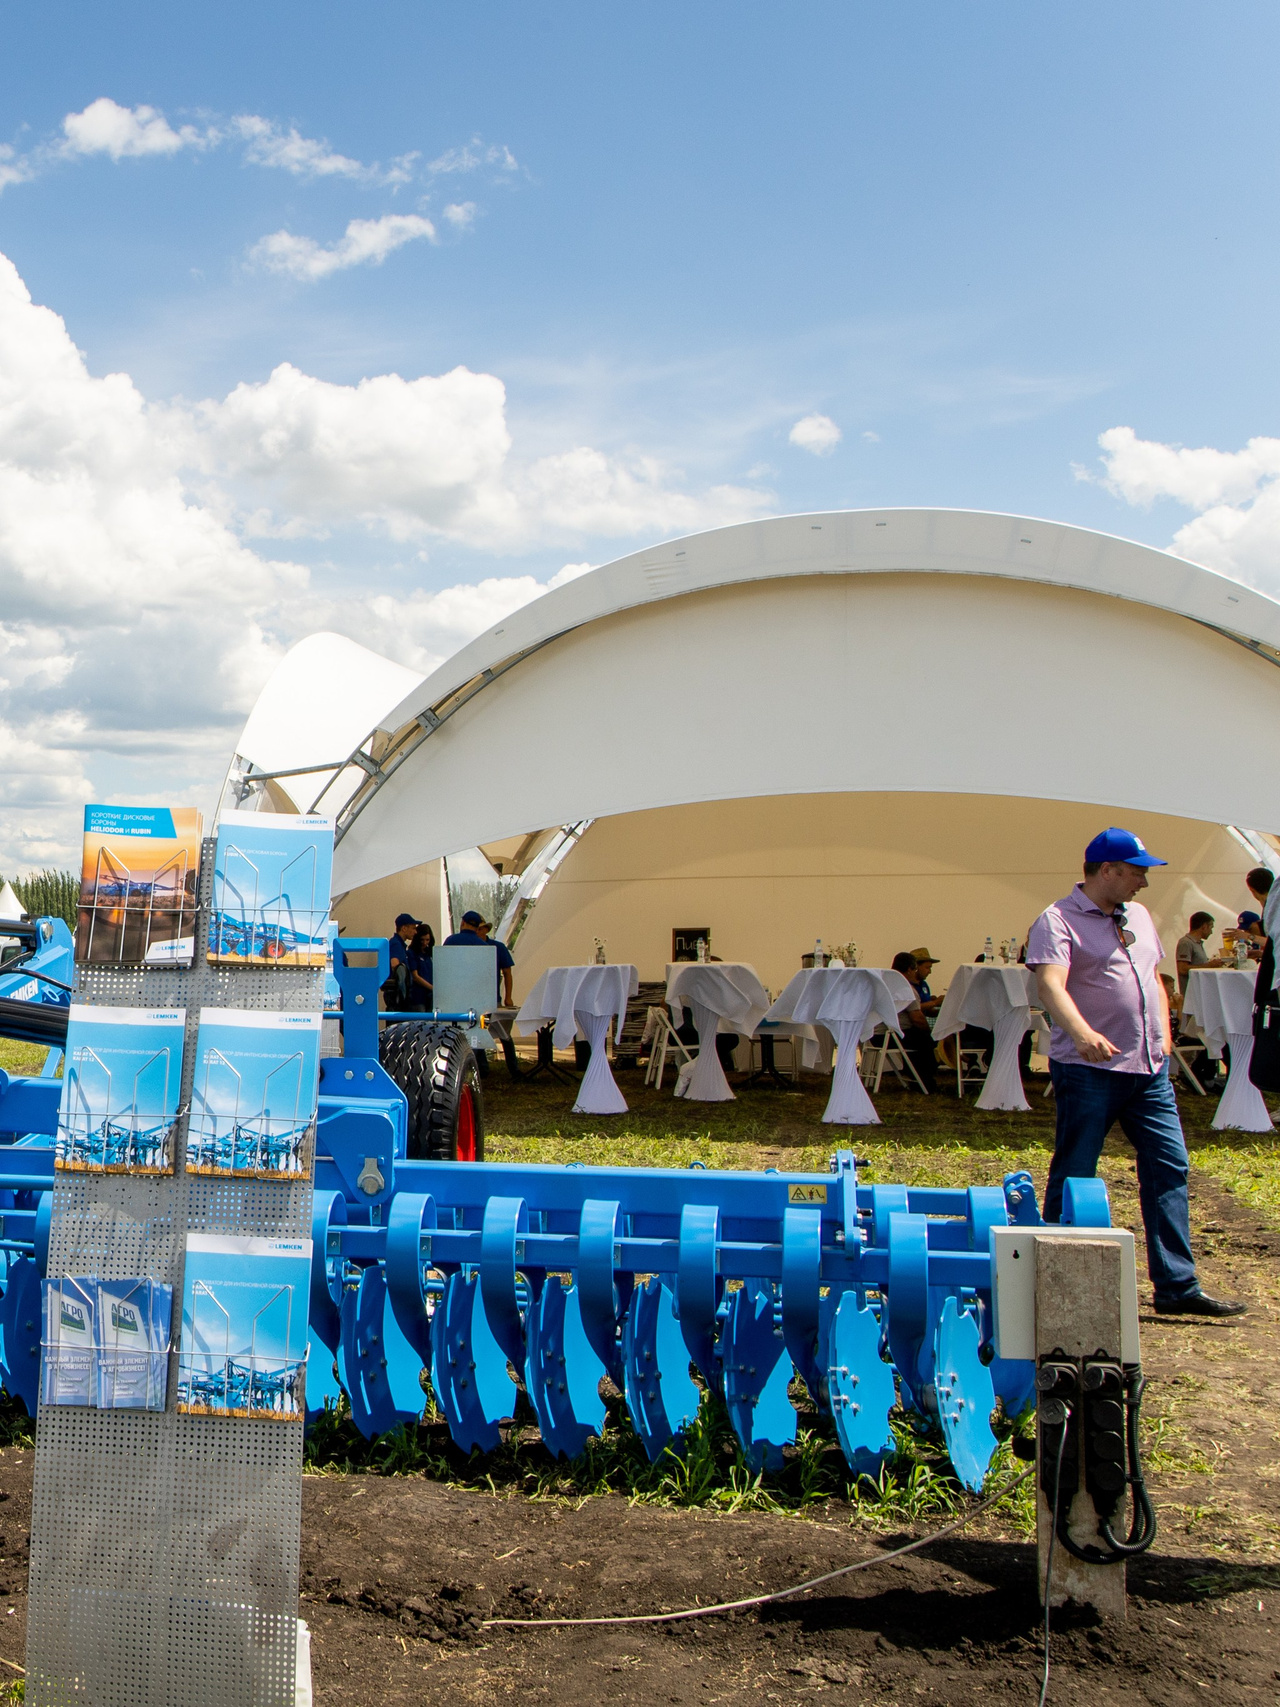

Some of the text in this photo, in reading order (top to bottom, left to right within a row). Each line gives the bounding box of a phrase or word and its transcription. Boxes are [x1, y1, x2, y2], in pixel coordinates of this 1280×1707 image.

[91, 812, 122, 820] КОРОТКИЕ
[90, 826, 124, 834] HELIODOR
[676, 936, 698, 951] Пив
[6, 977, 39, 1001] EMKEN
[61, 1301, 83, 1319] АГРО
[111, 1303, 136, 1320] АГРО
[45, 1355, 92, 1363] ВАЖЫЙ ЭЛЕМЕН
[99, 1358, 124, 1366] ВАЖНЙ
[108, 1365, 146, 1373] АГОБИЗНЕСЕ!
